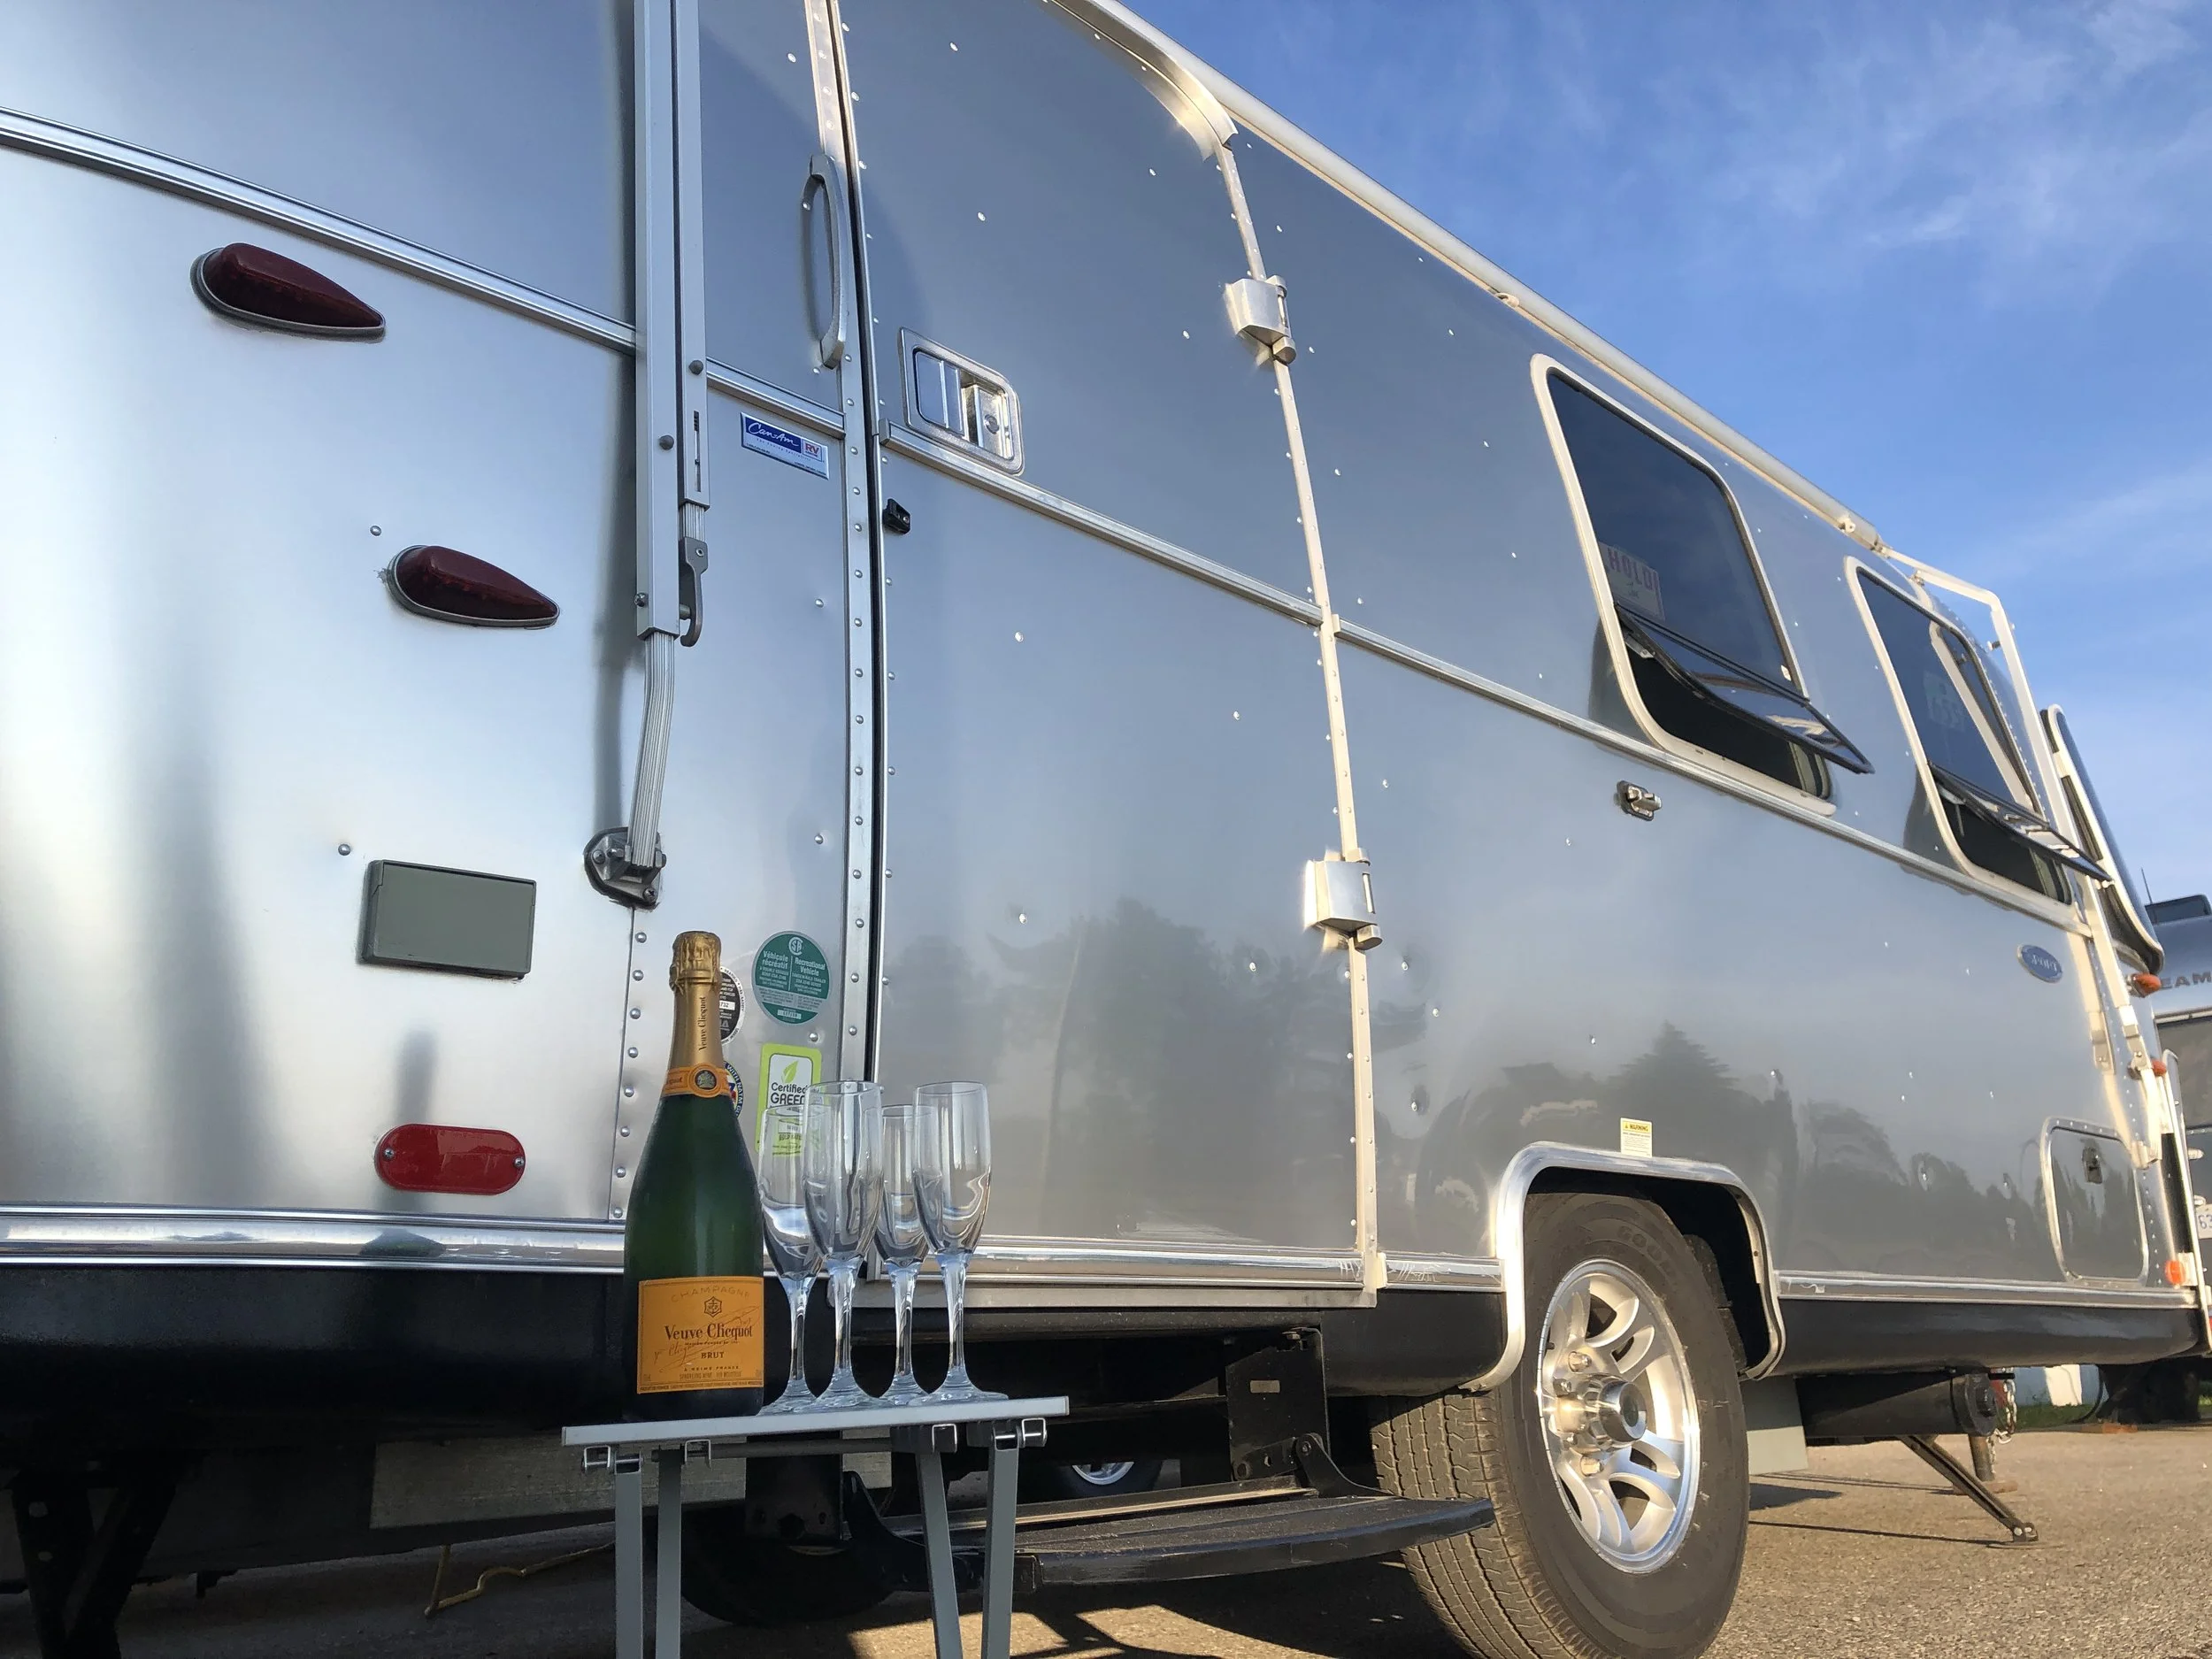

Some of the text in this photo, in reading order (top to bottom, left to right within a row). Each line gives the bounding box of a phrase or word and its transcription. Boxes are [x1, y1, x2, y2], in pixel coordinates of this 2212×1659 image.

[805, 442, 819, 455] RV
[795, 956, 826, 971] Recreational
[800, 965, 819, 977] Vehicle
[697, 996, 708, 1051] Veuve Clicquot
[727, 1064, 740, 1082] WITH
[771, 1081, 808, 1094] Certified
[671, 1285, 750, 1303] CHAMPAGNE
[664, 1323, 753, 1341] Veuve Clicquot
